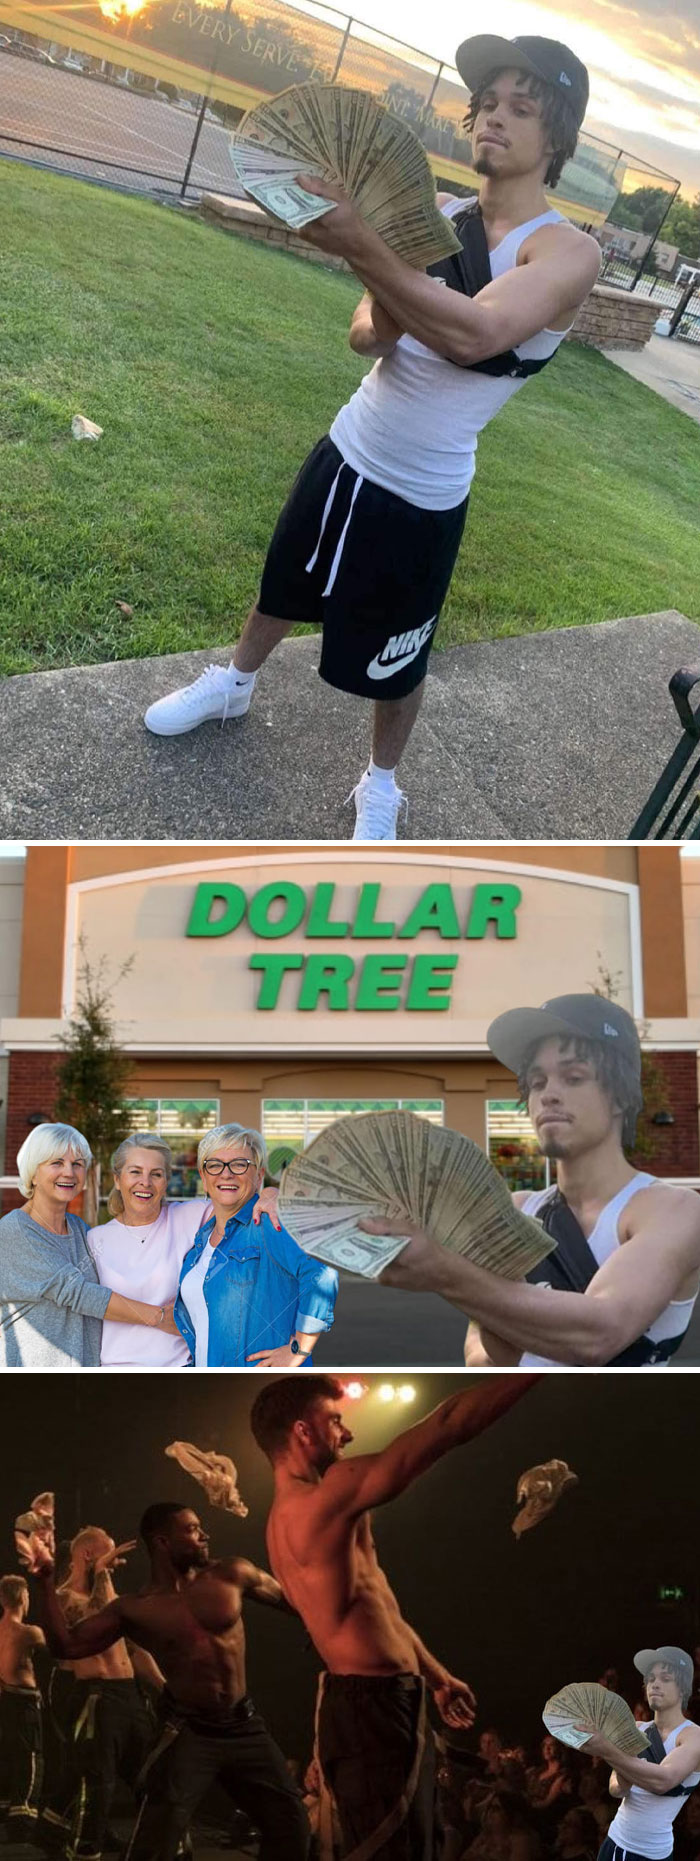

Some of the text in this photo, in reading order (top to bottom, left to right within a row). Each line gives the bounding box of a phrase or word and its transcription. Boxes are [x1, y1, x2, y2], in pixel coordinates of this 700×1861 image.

[172, 1, 241, 45] EVERY
[380, 614, 437, 661] NIKE
[185, 881, 522, 939] DOLLAR
[249, 953, 459, 1011] TREE
